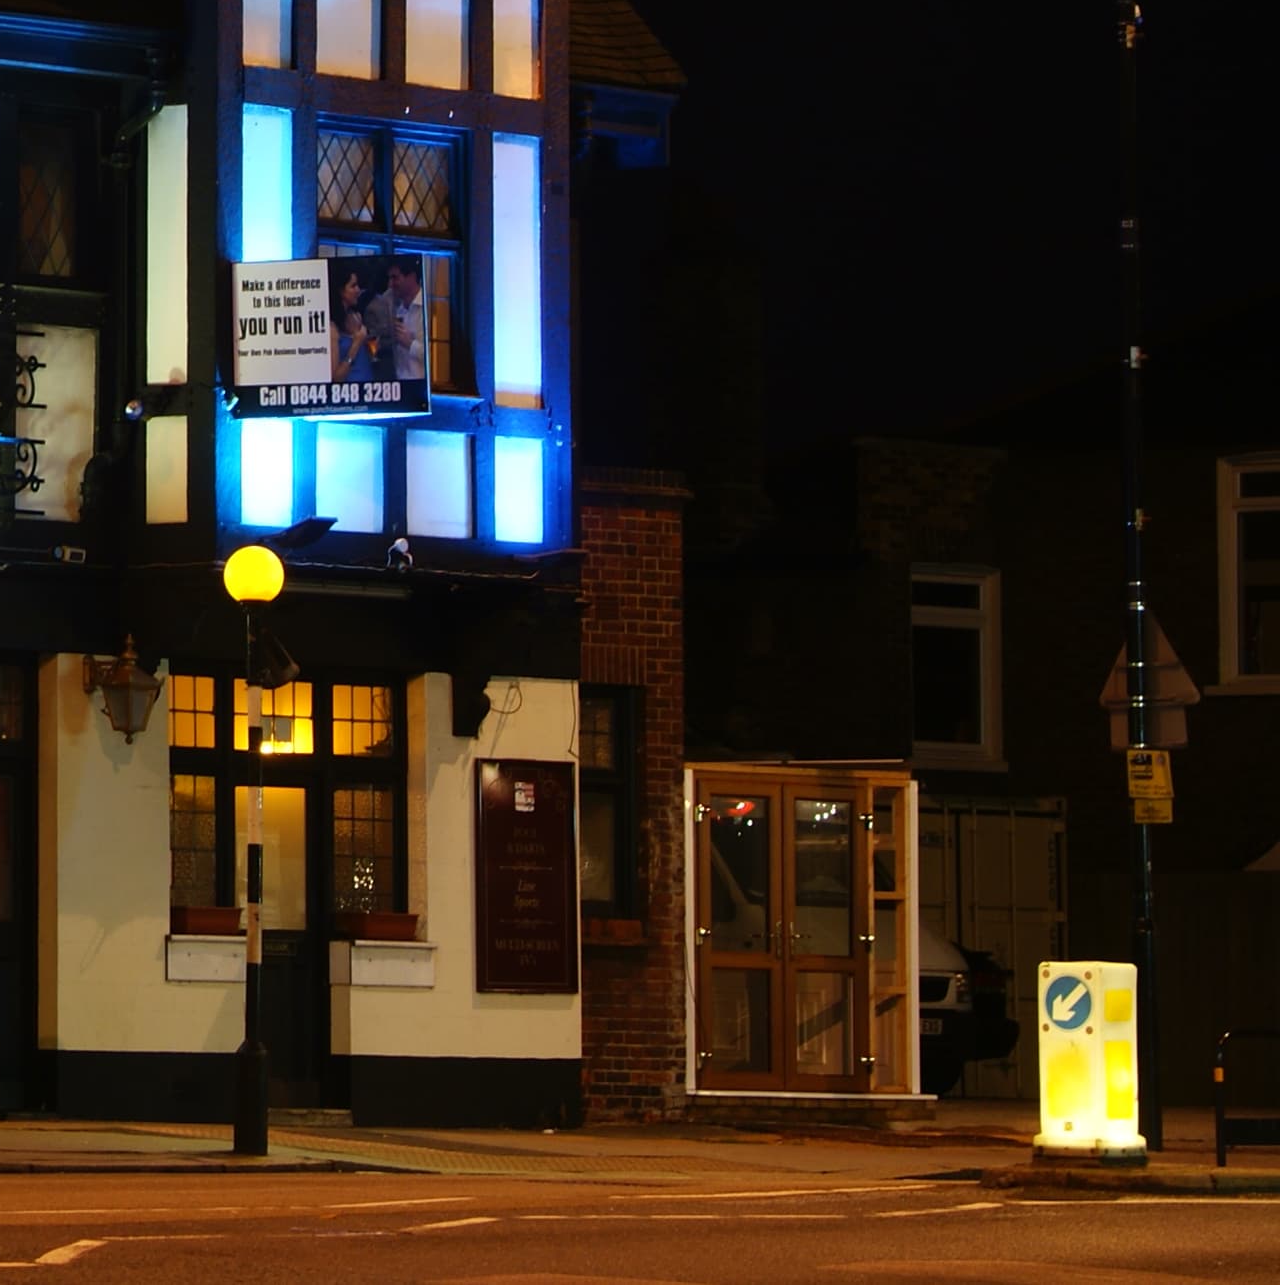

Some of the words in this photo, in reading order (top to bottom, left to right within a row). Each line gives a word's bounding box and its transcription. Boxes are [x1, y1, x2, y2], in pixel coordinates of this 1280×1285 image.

[242, 280, 265, 292] Make
[268, 281, 273, 291] a
[276, 278, 321, 290] difference
[253, 297, 261, 308] to
[264, 295, 281, 308] this
[283, 295, 305, 307] local
[239, 317, 268, 340] you
[274, 316, 303, 335] run
[309, 310, 326, 334] it!
[260, 386, 286, 406] Call
[290, 385, 327, 405] 0844
[331, 383, 360, 404] 848
[363, 382, 401, 403] 3280
